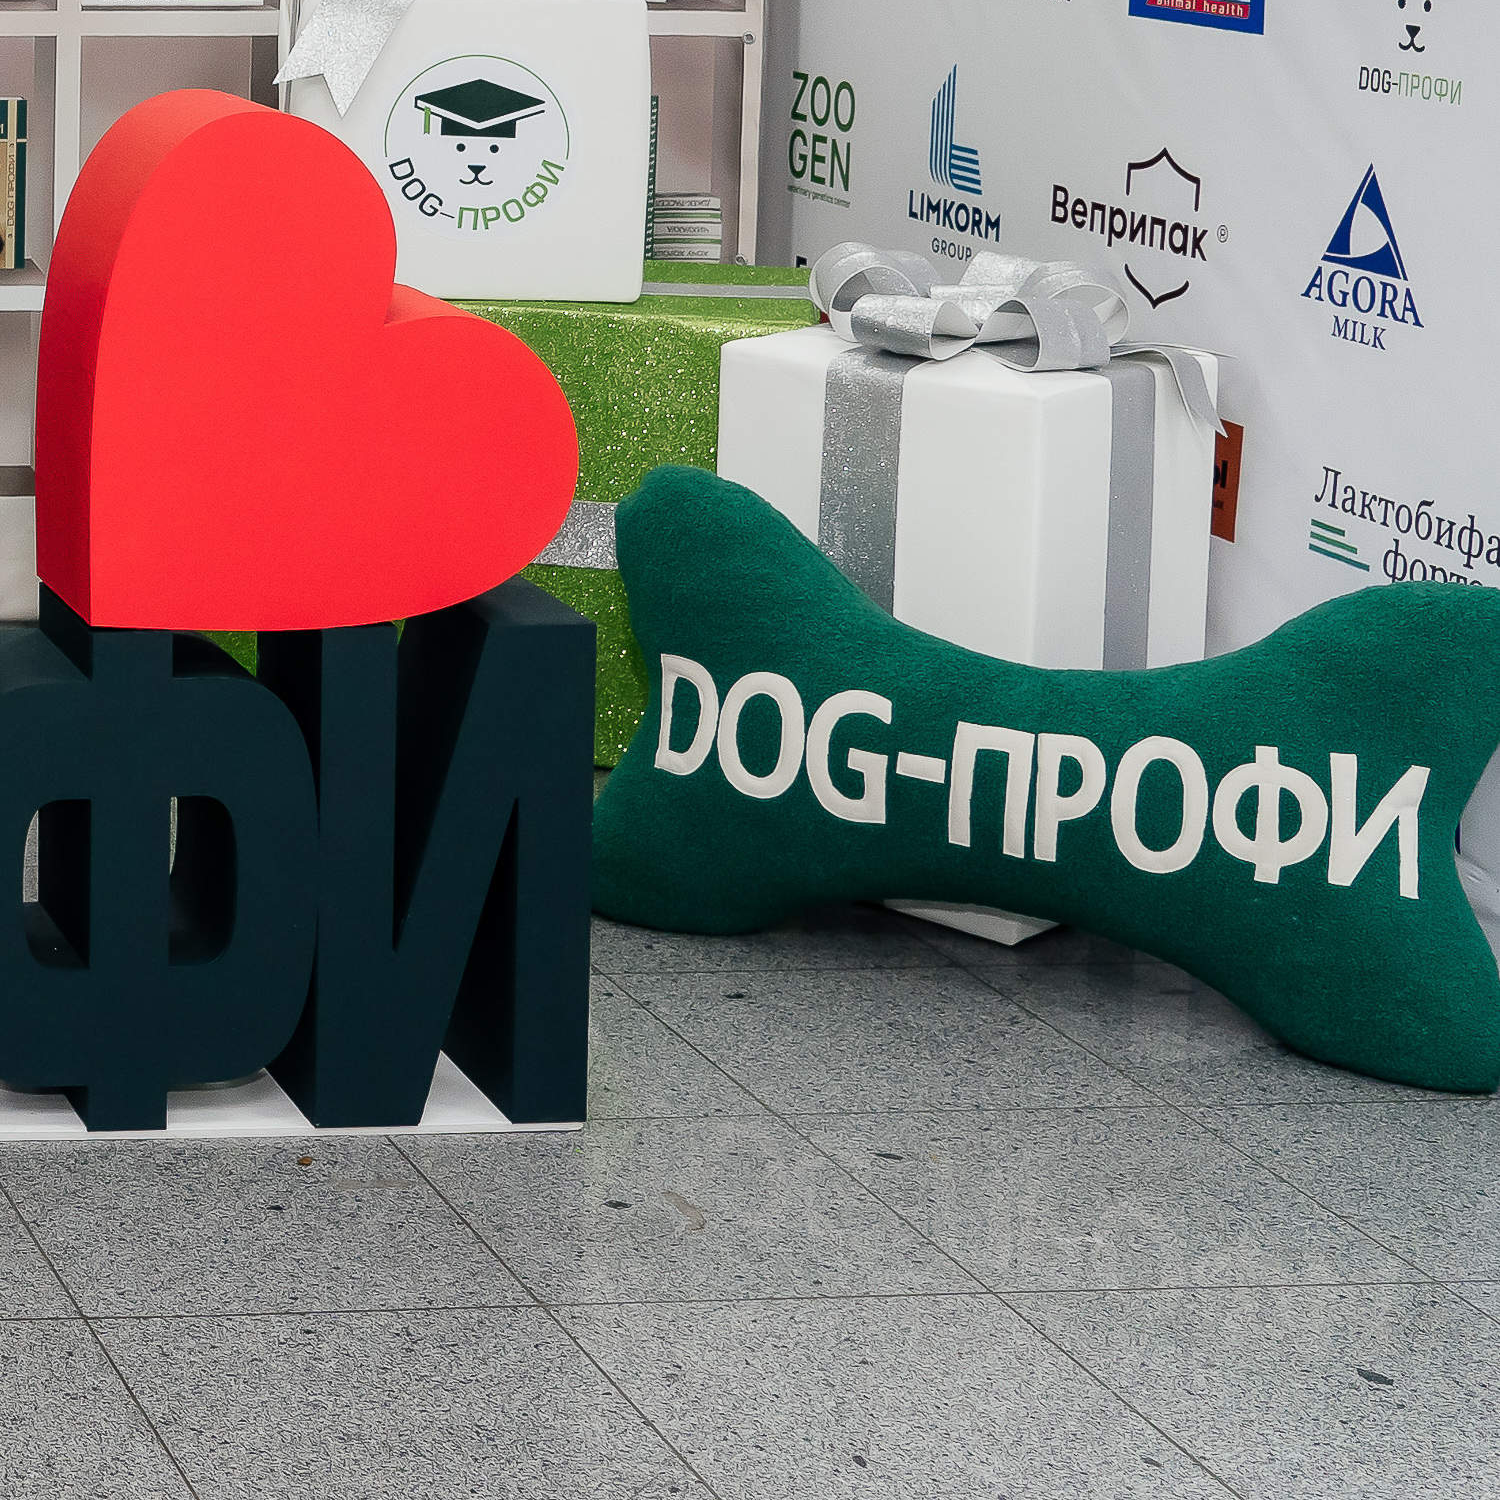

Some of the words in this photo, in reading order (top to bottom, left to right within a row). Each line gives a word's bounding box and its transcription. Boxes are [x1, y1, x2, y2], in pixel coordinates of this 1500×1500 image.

[790, 70, 856, 133] ZOO
[1357, 65, 1464, 108] DOG-ПРОФИ
[788, 128, 851, 193] GEN
[387, 156, 566, 232] DOG-ПРОФИ
[907, 188, 1002, 244] LIMKORM
[1049, 182, 1209, 264] Веприпак
[931, 237, 972, 263] GROUP
[1300, 264, 1425, 330] AGORA
[1330, 314, 1388, 353] MILK
[652, 651, 1433, 901] DOG-ПРОФИ
